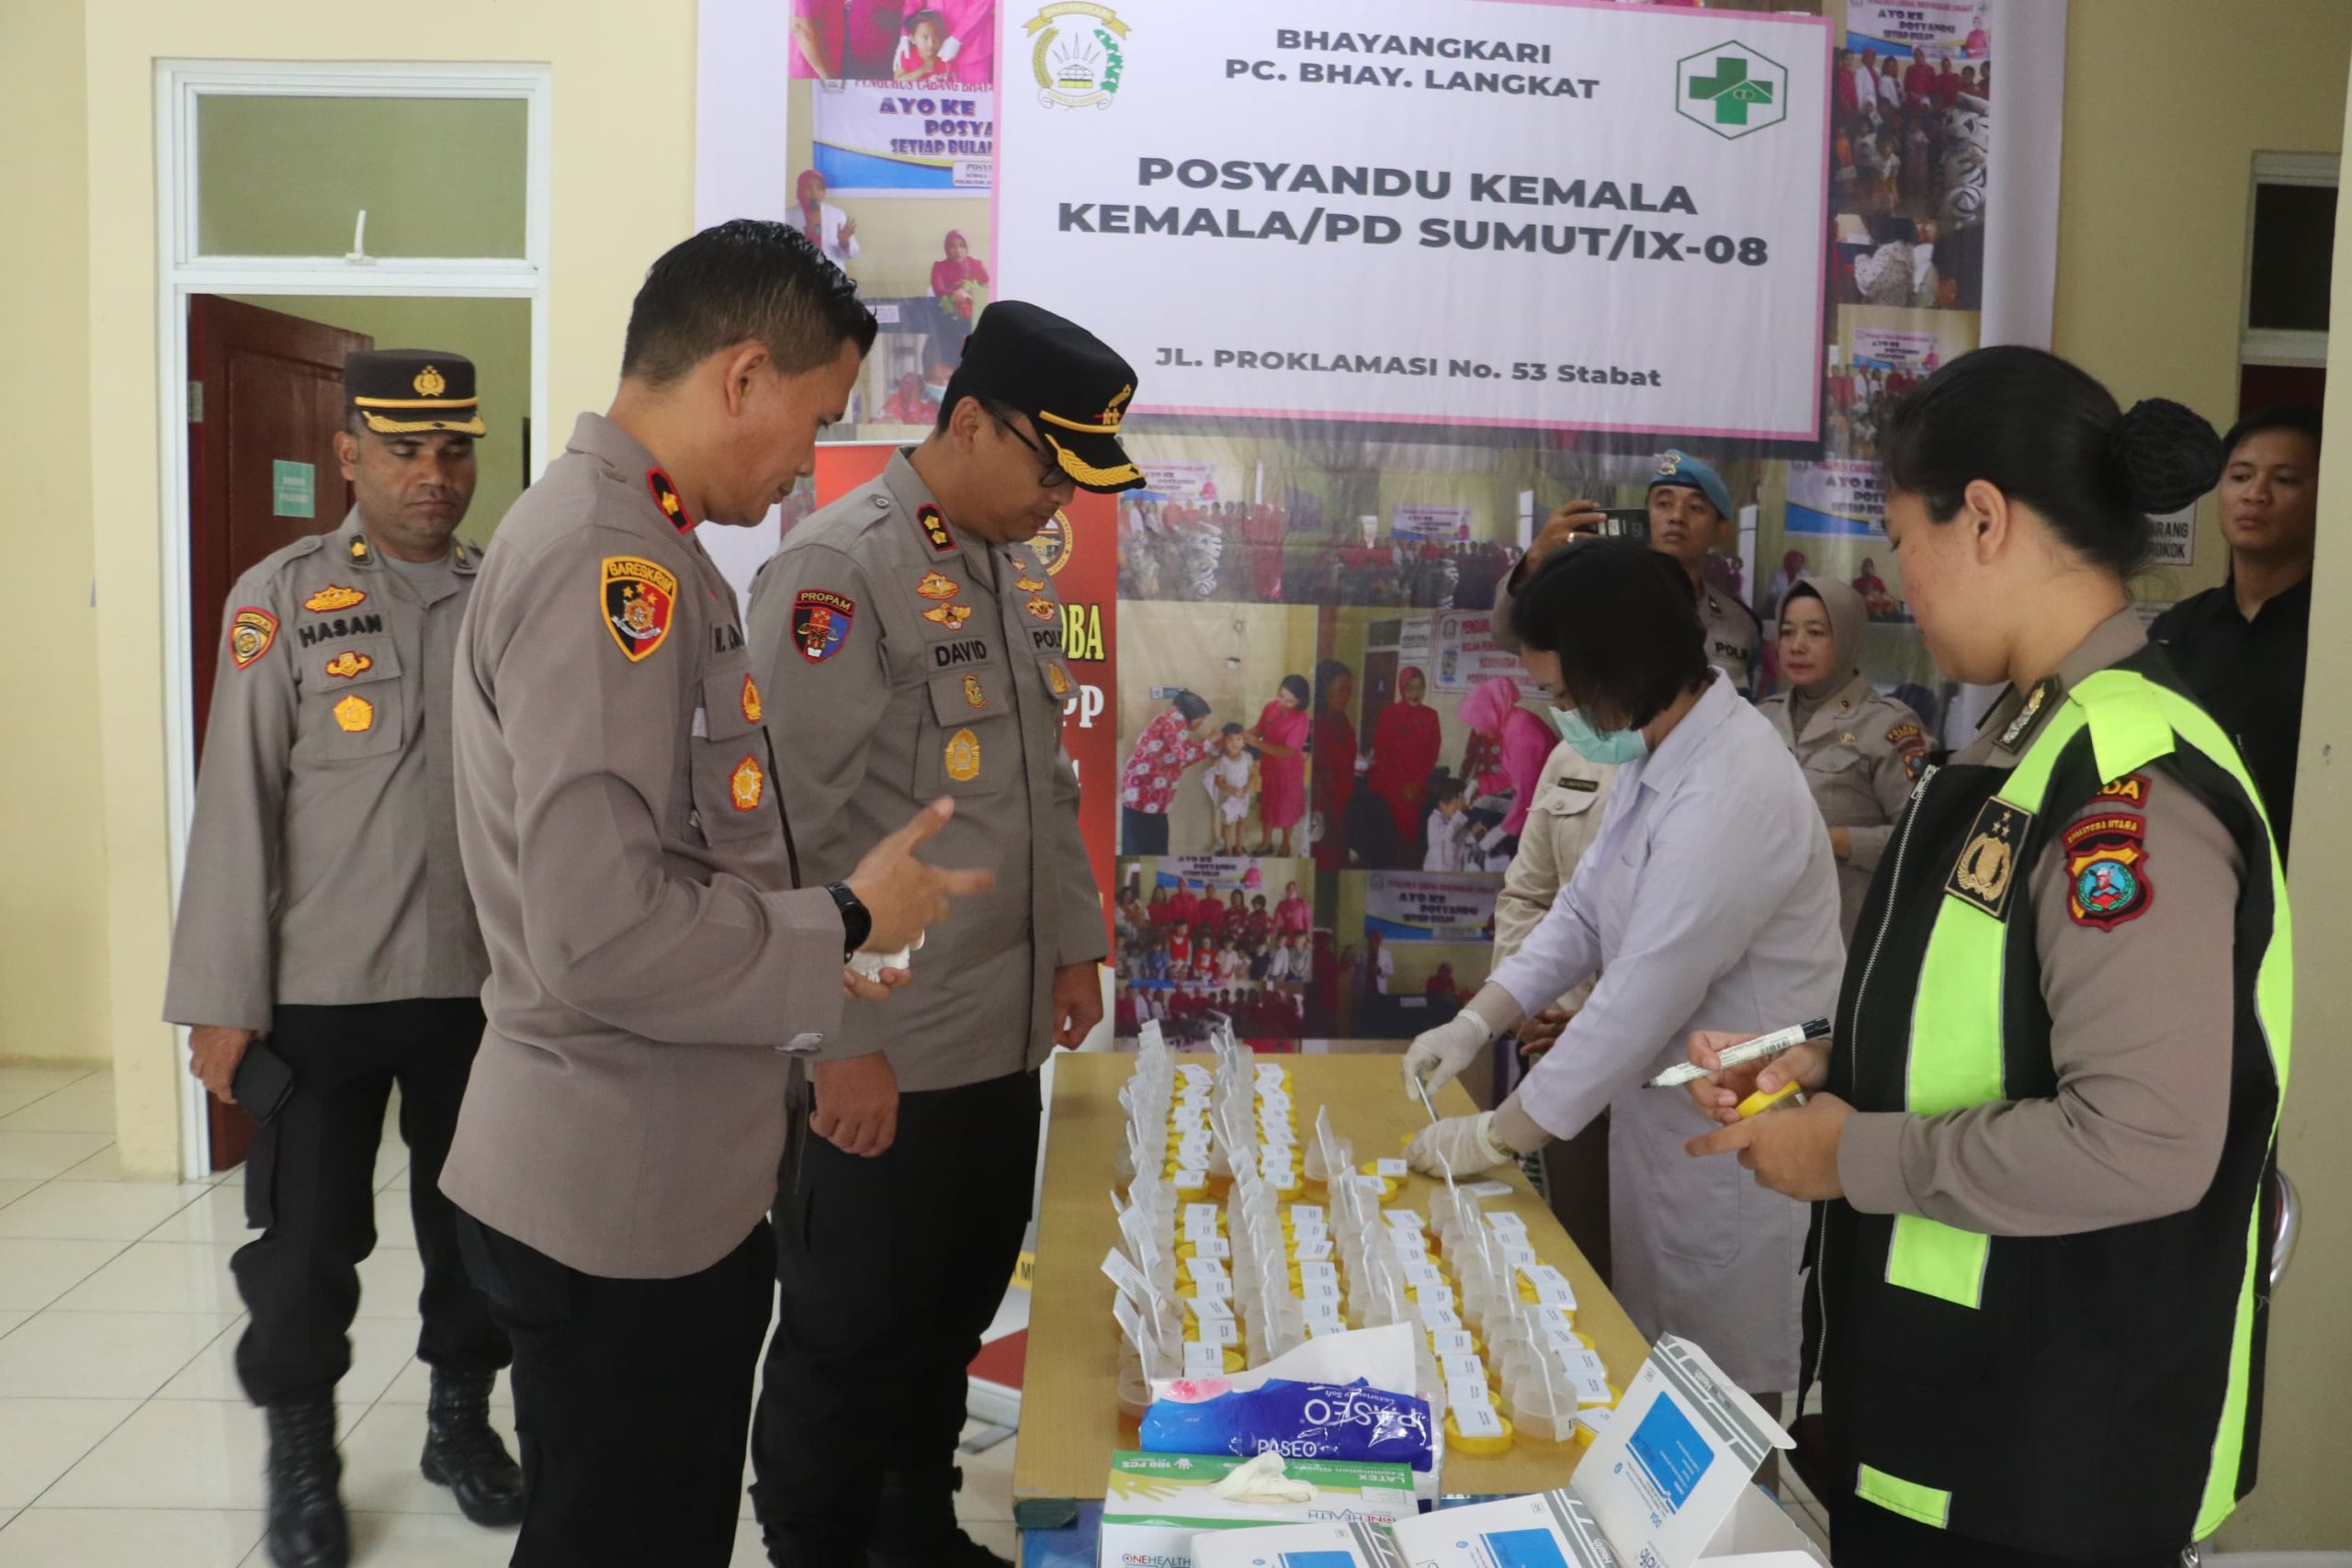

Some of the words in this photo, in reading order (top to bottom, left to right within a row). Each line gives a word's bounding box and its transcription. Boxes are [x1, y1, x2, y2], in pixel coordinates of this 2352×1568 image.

[1276, 28, 1551, 64] BHAYANGKARI
[1226, 59, 1287, 82] PC.
[1299, 62, 1413, 88] BHAY.
[1425, 70, 1600, 99] LANGKAT
[879, 96, 935, 116] AYO
[941, 98, 976, 117] KE
[890, 139, 944, 155] SETIAP
[1138, 157, 1451, 200] POSYANDU
[1470, 173, 1699, 215] KEMALA
[1058, 203, 1402, 245] KEMALA/PD
[1419, 218, 1769, 266] SUMUT/IX-08
[1154, 347, 1204, 367] JL.
[1214, 349, 1438, 377] PROKLAMASI
[1448, 359, 1501, 379] No.
[1511, 362, 1547, 381] 53
[1557, 364, 1661, 388] Stabat
[608, 562, 673, 592] BARESKRIM
[801, 592, 852, 610] PROPAM
[299, 615, 382, 649] HASAN
[935, 640, 987, 667] DAVID
[1305, 1398, 1418, 1428] PASEO
[1257, 1439, 1317, 1458] PASEO
[1359, 1473, 1406, 1483] LATEX
